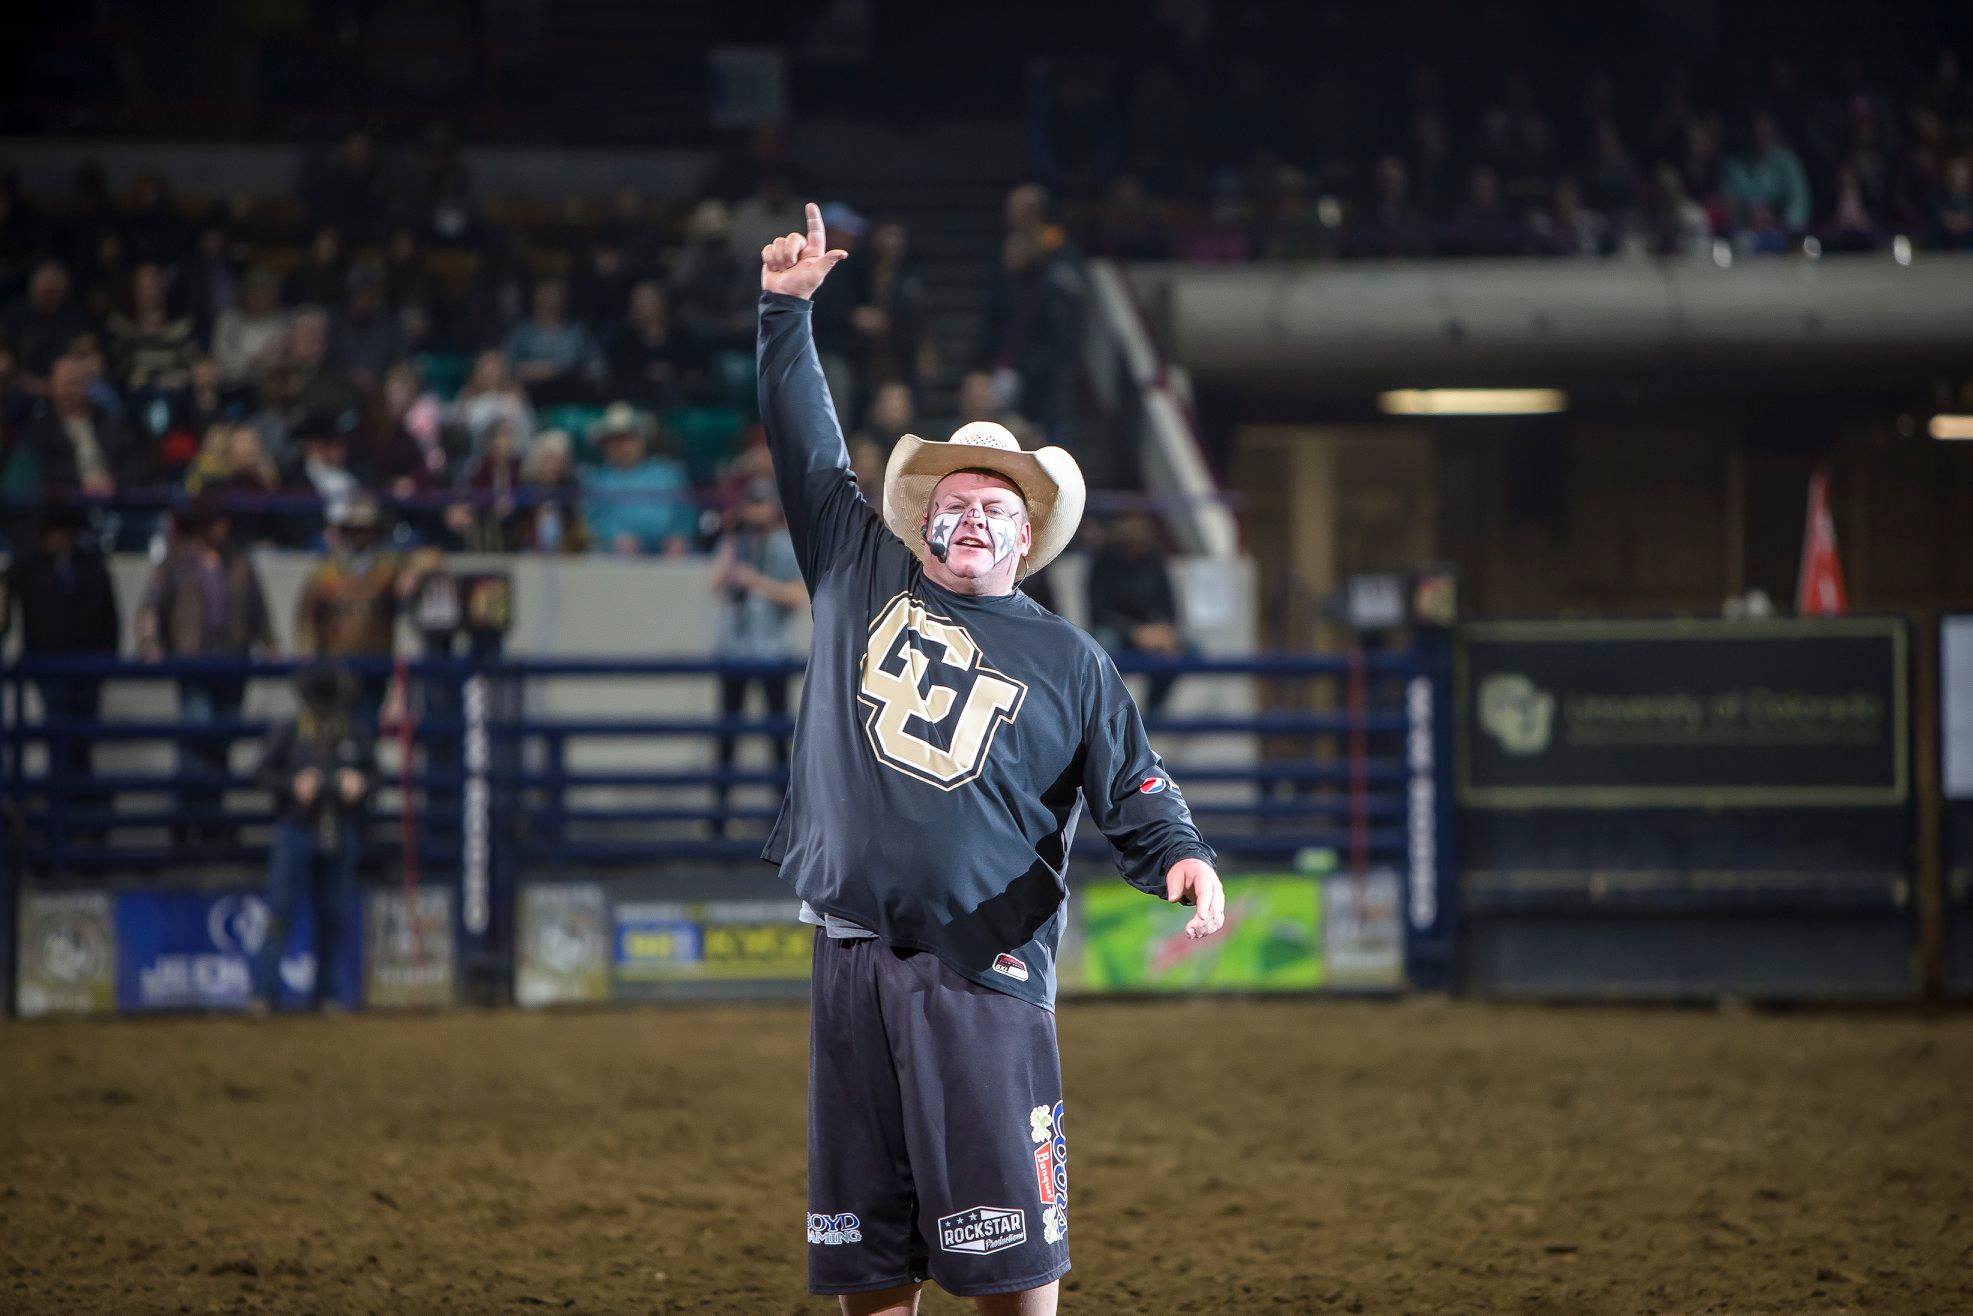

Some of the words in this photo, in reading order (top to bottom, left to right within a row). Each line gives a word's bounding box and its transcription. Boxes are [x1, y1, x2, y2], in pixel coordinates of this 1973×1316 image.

[857, 590, 1029, 792] CU
[1036, 1150, 1054, 1200] Banquet
[807, 1211, 861, 1231] OYD
[944, 1213, 1021, 1245] ROCKSTAR
[807, 1230, 862, 1245] AMING
[985, 1232, 1024, 1251] Productions
